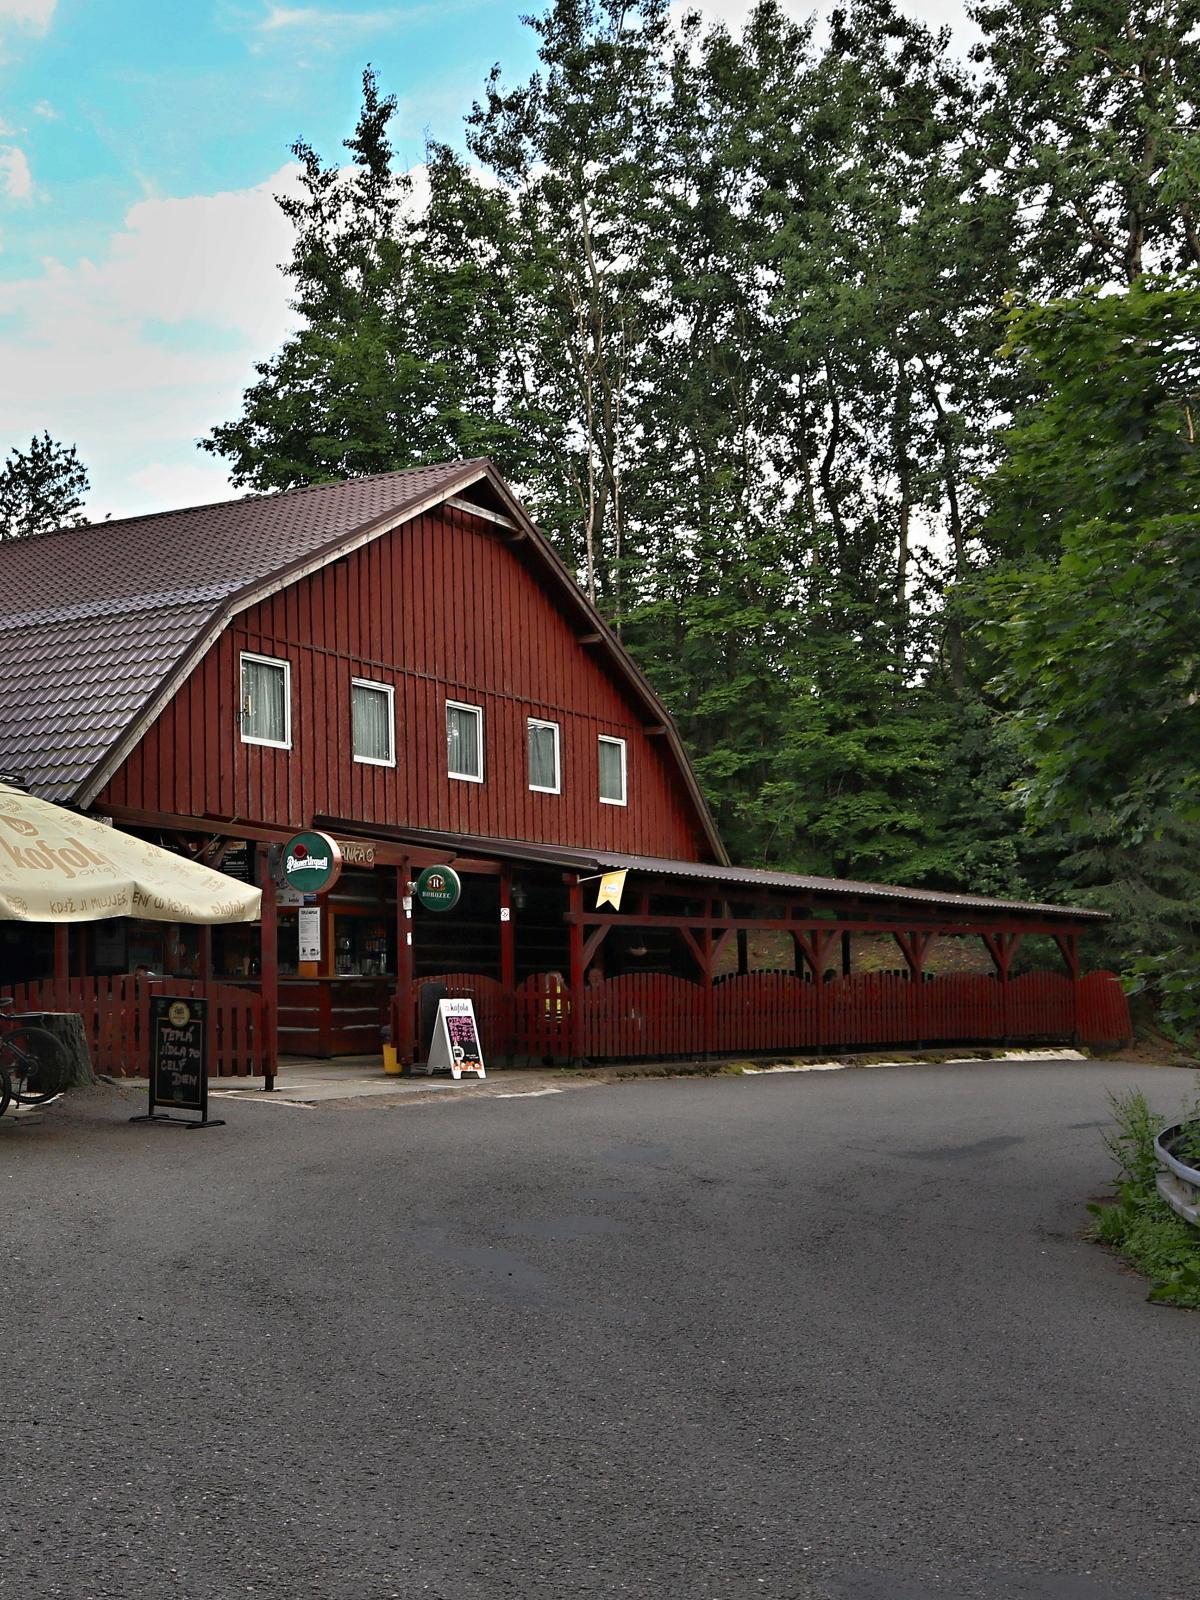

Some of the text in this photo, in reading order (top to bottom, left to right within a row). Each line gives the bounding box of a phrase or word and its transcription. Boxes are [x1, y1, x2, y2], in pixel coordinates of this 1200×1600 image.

[287, 855, 328, 873] Pilsner Urquell
[422, 891, 451, 899] ROHOZEC
[450, 1002, 469, 1014] kofola
[161, 1026, 194, 1042] TEPLÁ
[160, 1042, 187, 1057] JÍDLA
[171, 1072, 197, 1087] DEN
